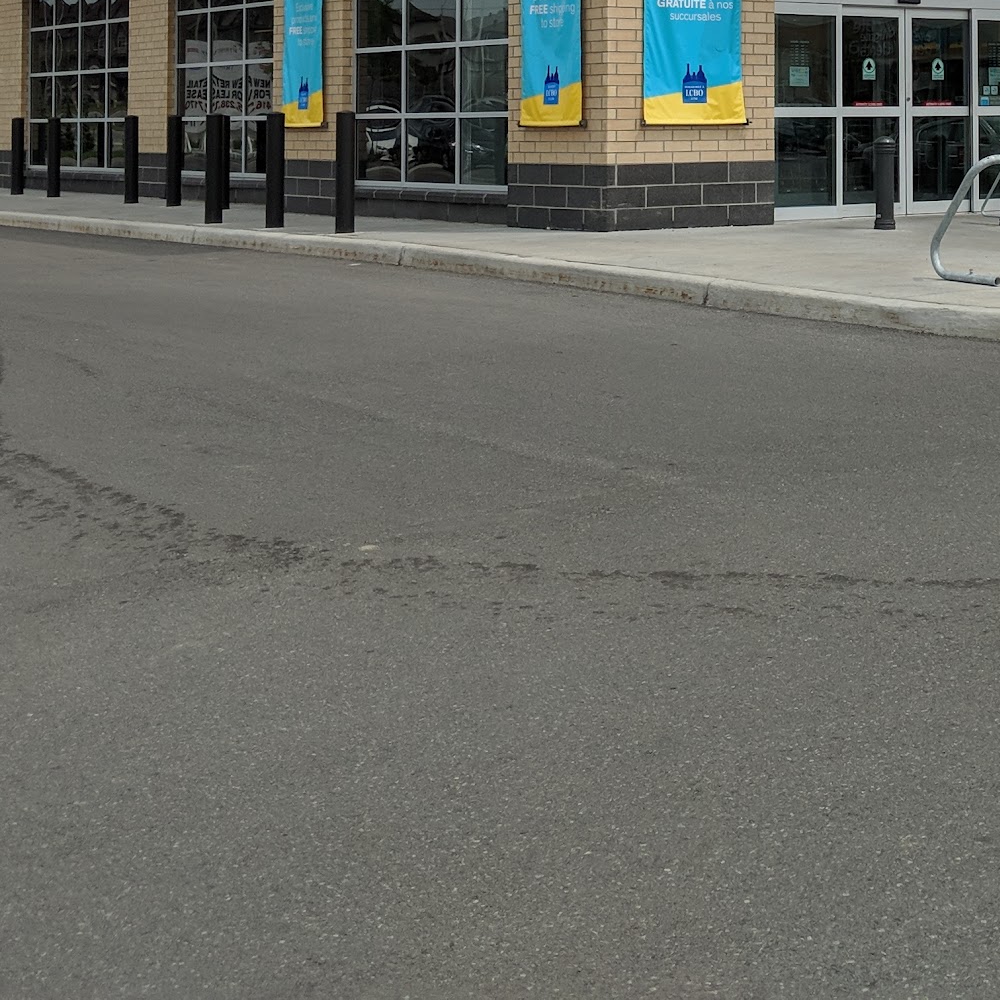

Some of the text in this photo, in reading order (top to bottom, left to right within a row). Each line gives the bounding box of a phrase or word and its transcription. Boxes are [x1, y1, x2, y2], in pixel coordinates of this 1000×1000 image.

[529, 4, 548, 14] FREE
[708, 0, 715, 10] à
[716, 2, 734, 10] nos
[669, 12, 722, 22] succursales
[685, 89, 704, 97] LCBO
